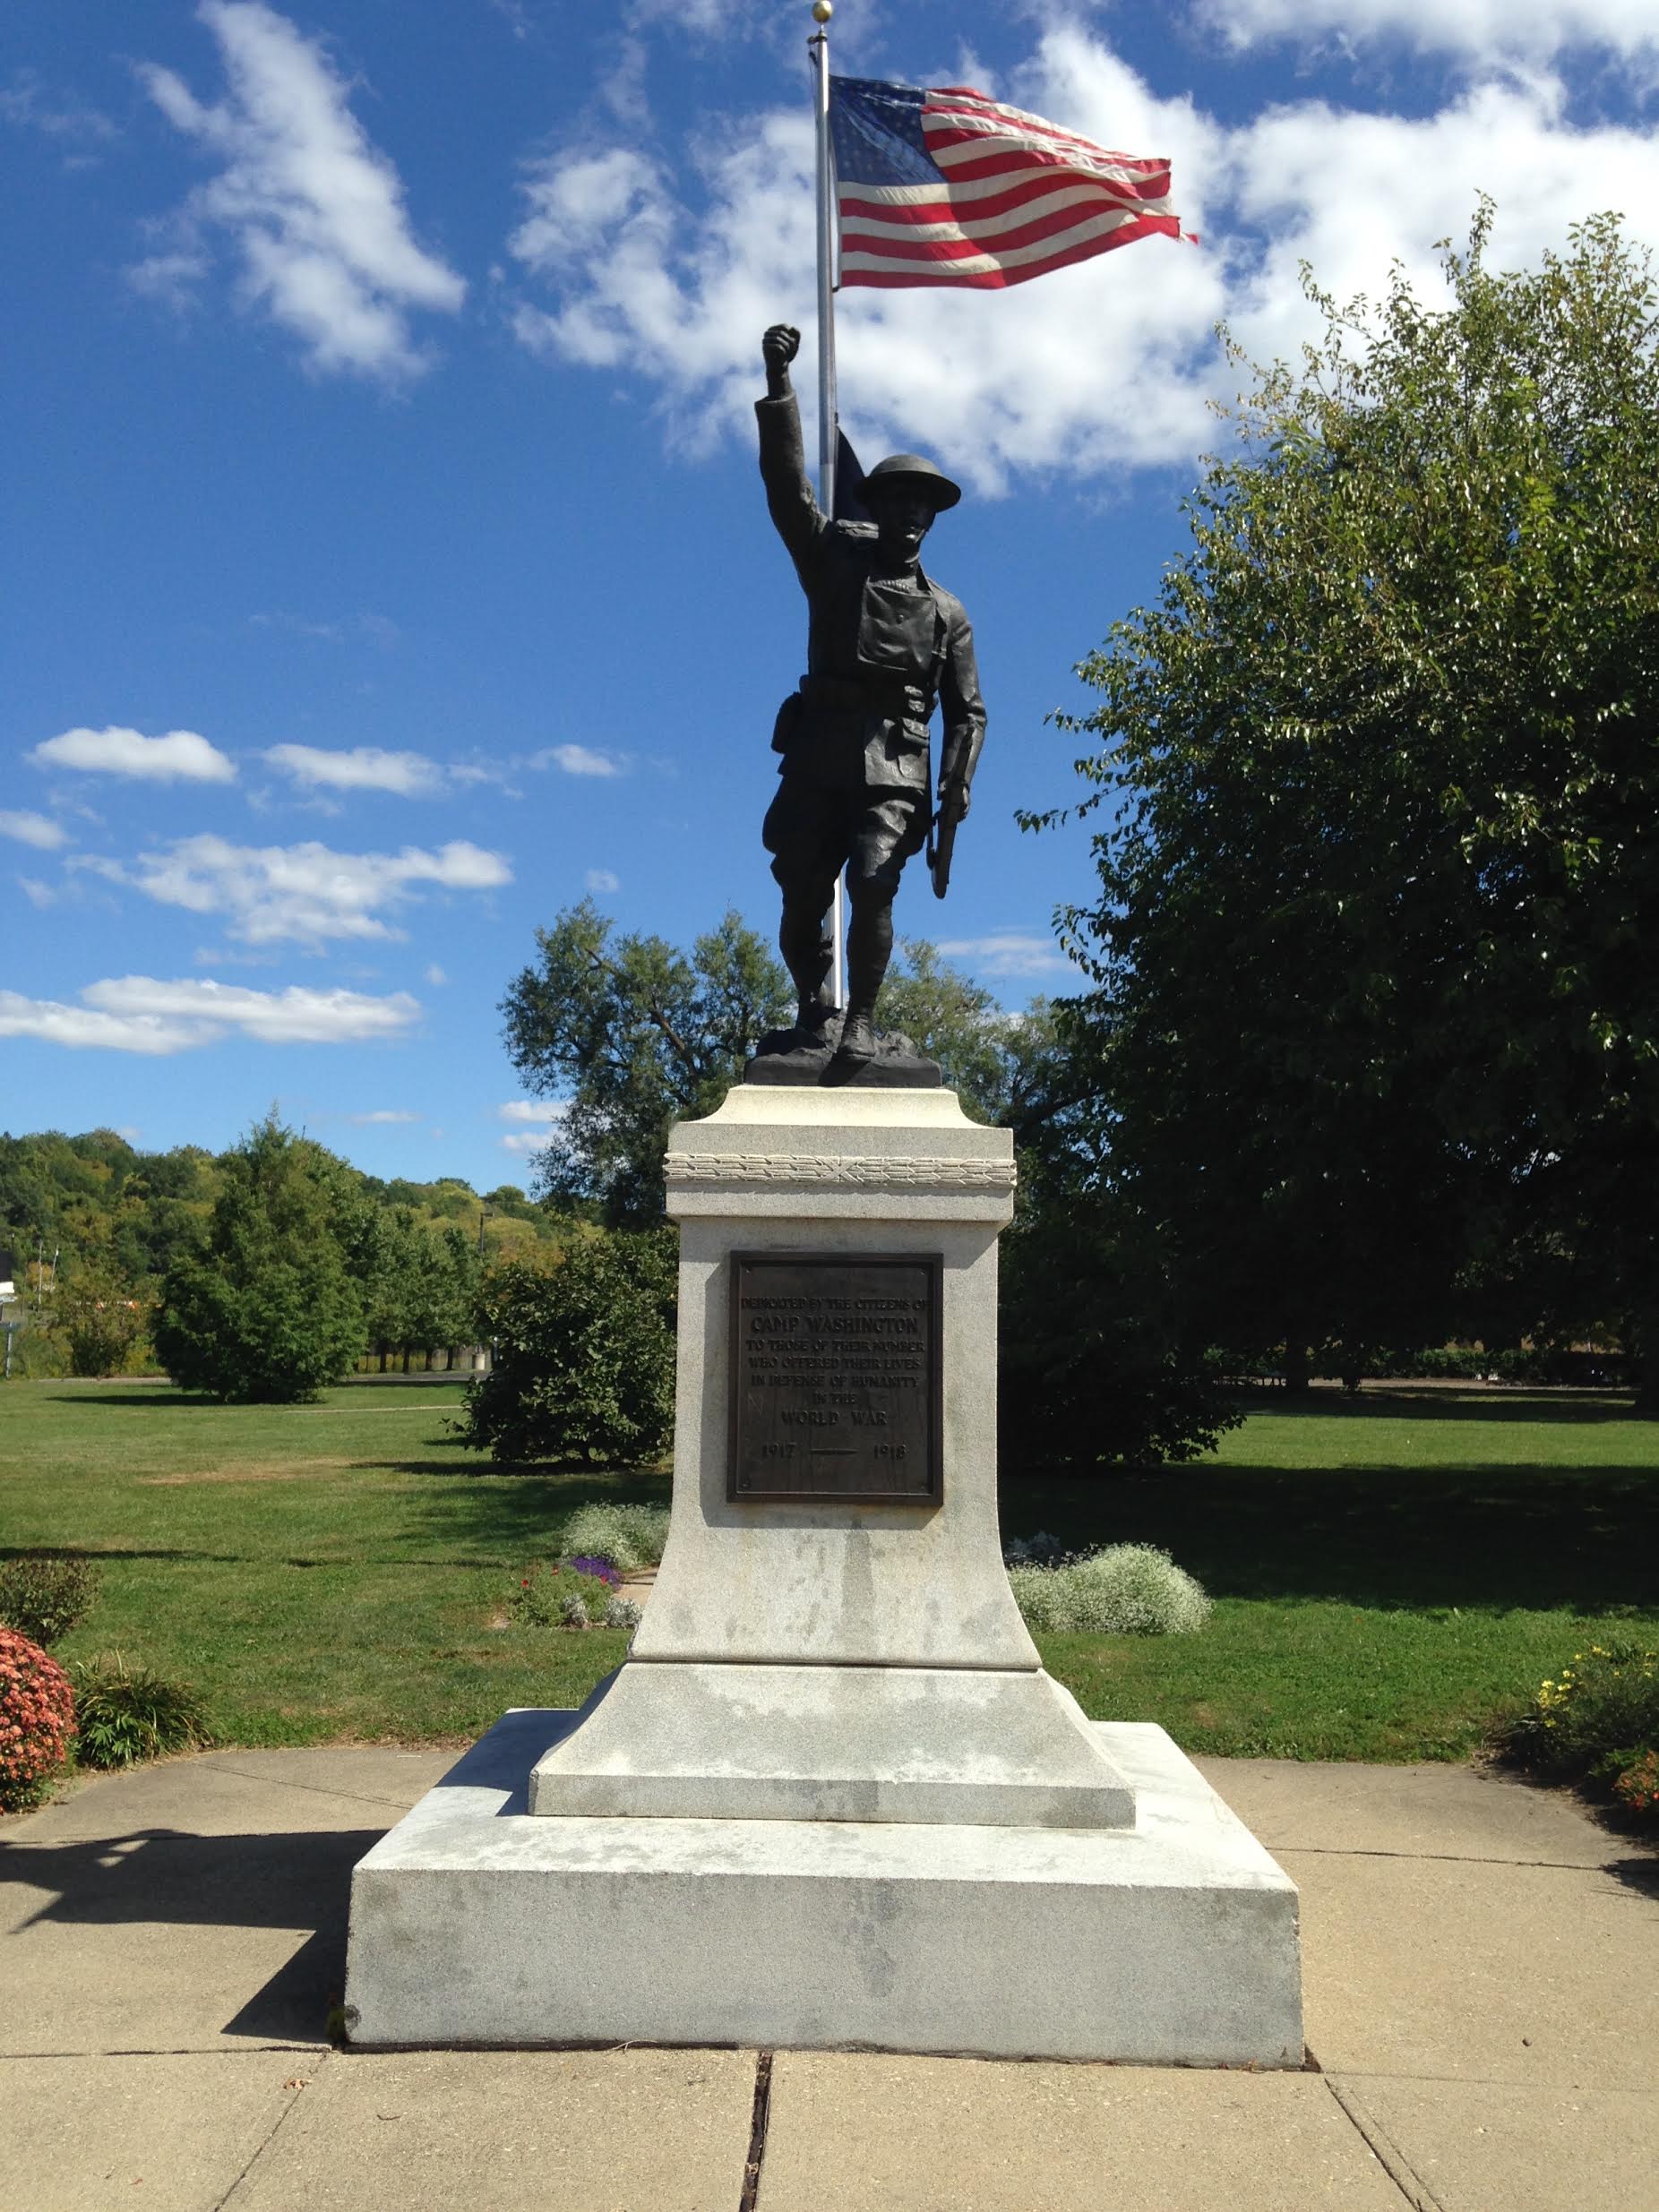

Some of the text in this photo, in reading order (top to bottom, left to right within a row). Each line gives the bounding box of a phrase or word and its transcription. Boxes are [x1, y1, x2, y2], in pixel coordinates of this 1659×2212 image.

[809, 1298, 821, 1311] BY
[827, 1298, 851, 1311] THE
[855, 1298, 910, 1311] CITIZENS
[751, 1316, 918, 1334] CAMP WASHINGTON
[745, 1340, 924, 1353] TO THOSE OF THEIR NUMBER
[748, 1357, 921, 1369] WHO OFFERED THEIR LIVES
[751, 1375, 918, 1388] IN DEFENSE OF HUMANITY
[812, 1393, 858, 1405] IN THE
[781, 1411, 888, 1427] WORLD WAR
[761, 1443, 907, 1460] 1917 1918
